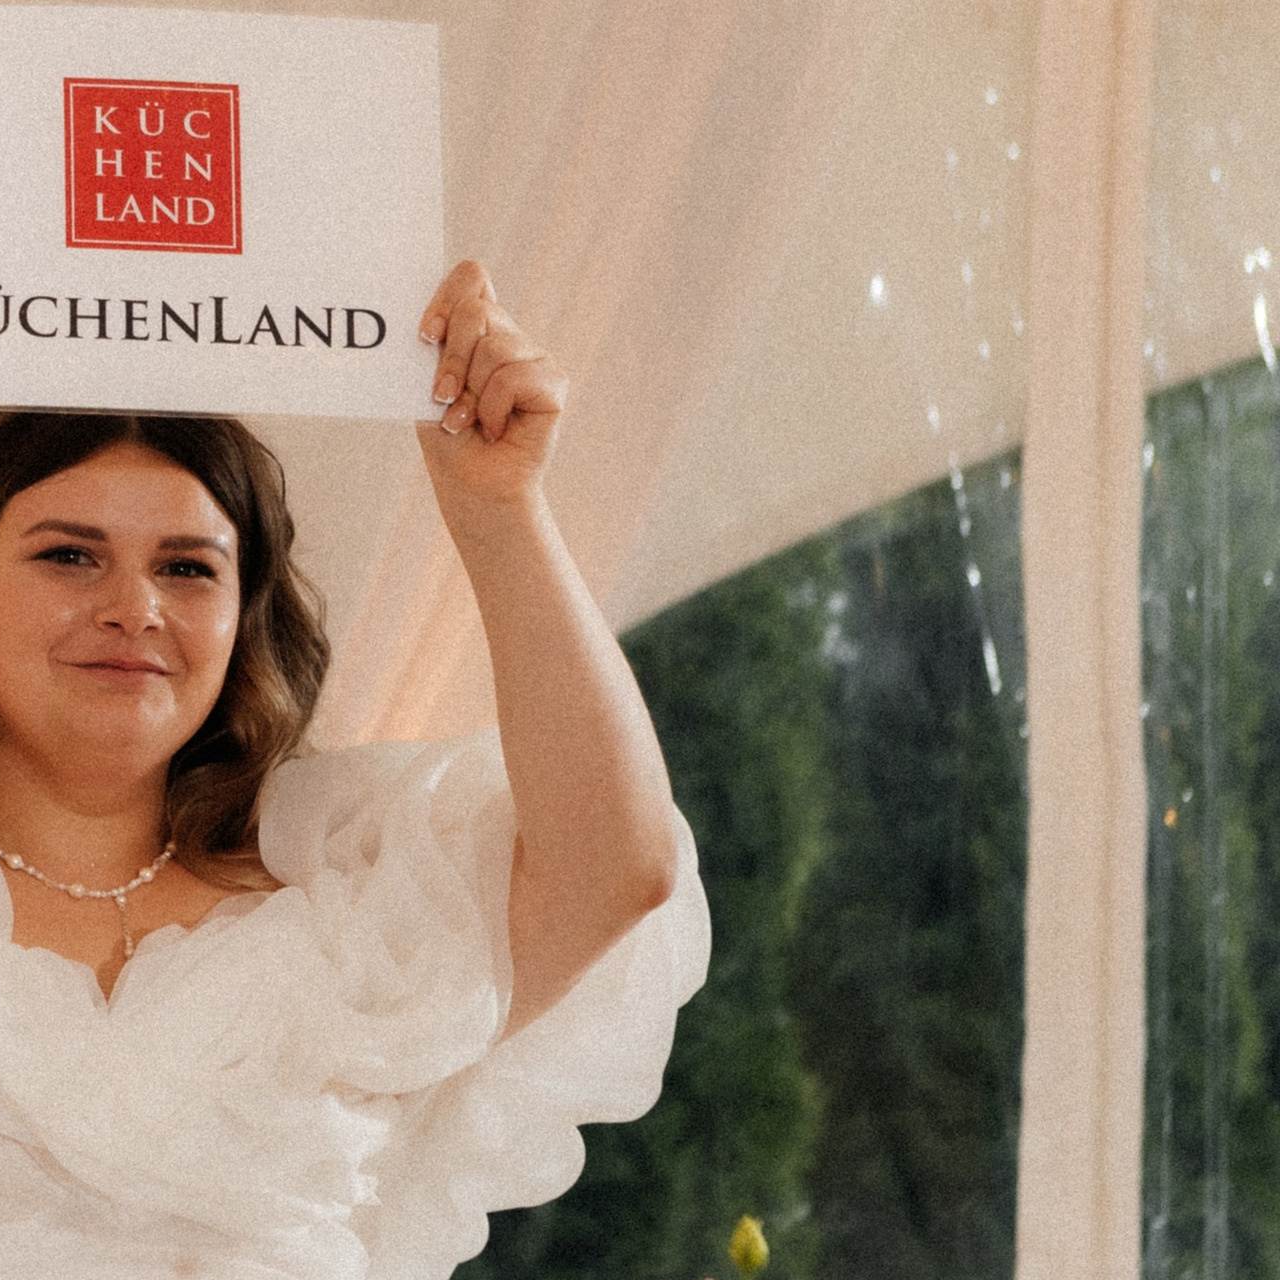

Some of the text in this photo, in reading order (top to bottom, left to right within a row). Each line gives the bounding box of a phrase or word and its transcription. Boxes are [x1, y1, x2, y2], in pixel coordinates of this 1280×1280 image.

[94, 101, 211, 140] KÜC
[94, 149, 212, 182] HEN
[95, 192, 216, 226] LAND
